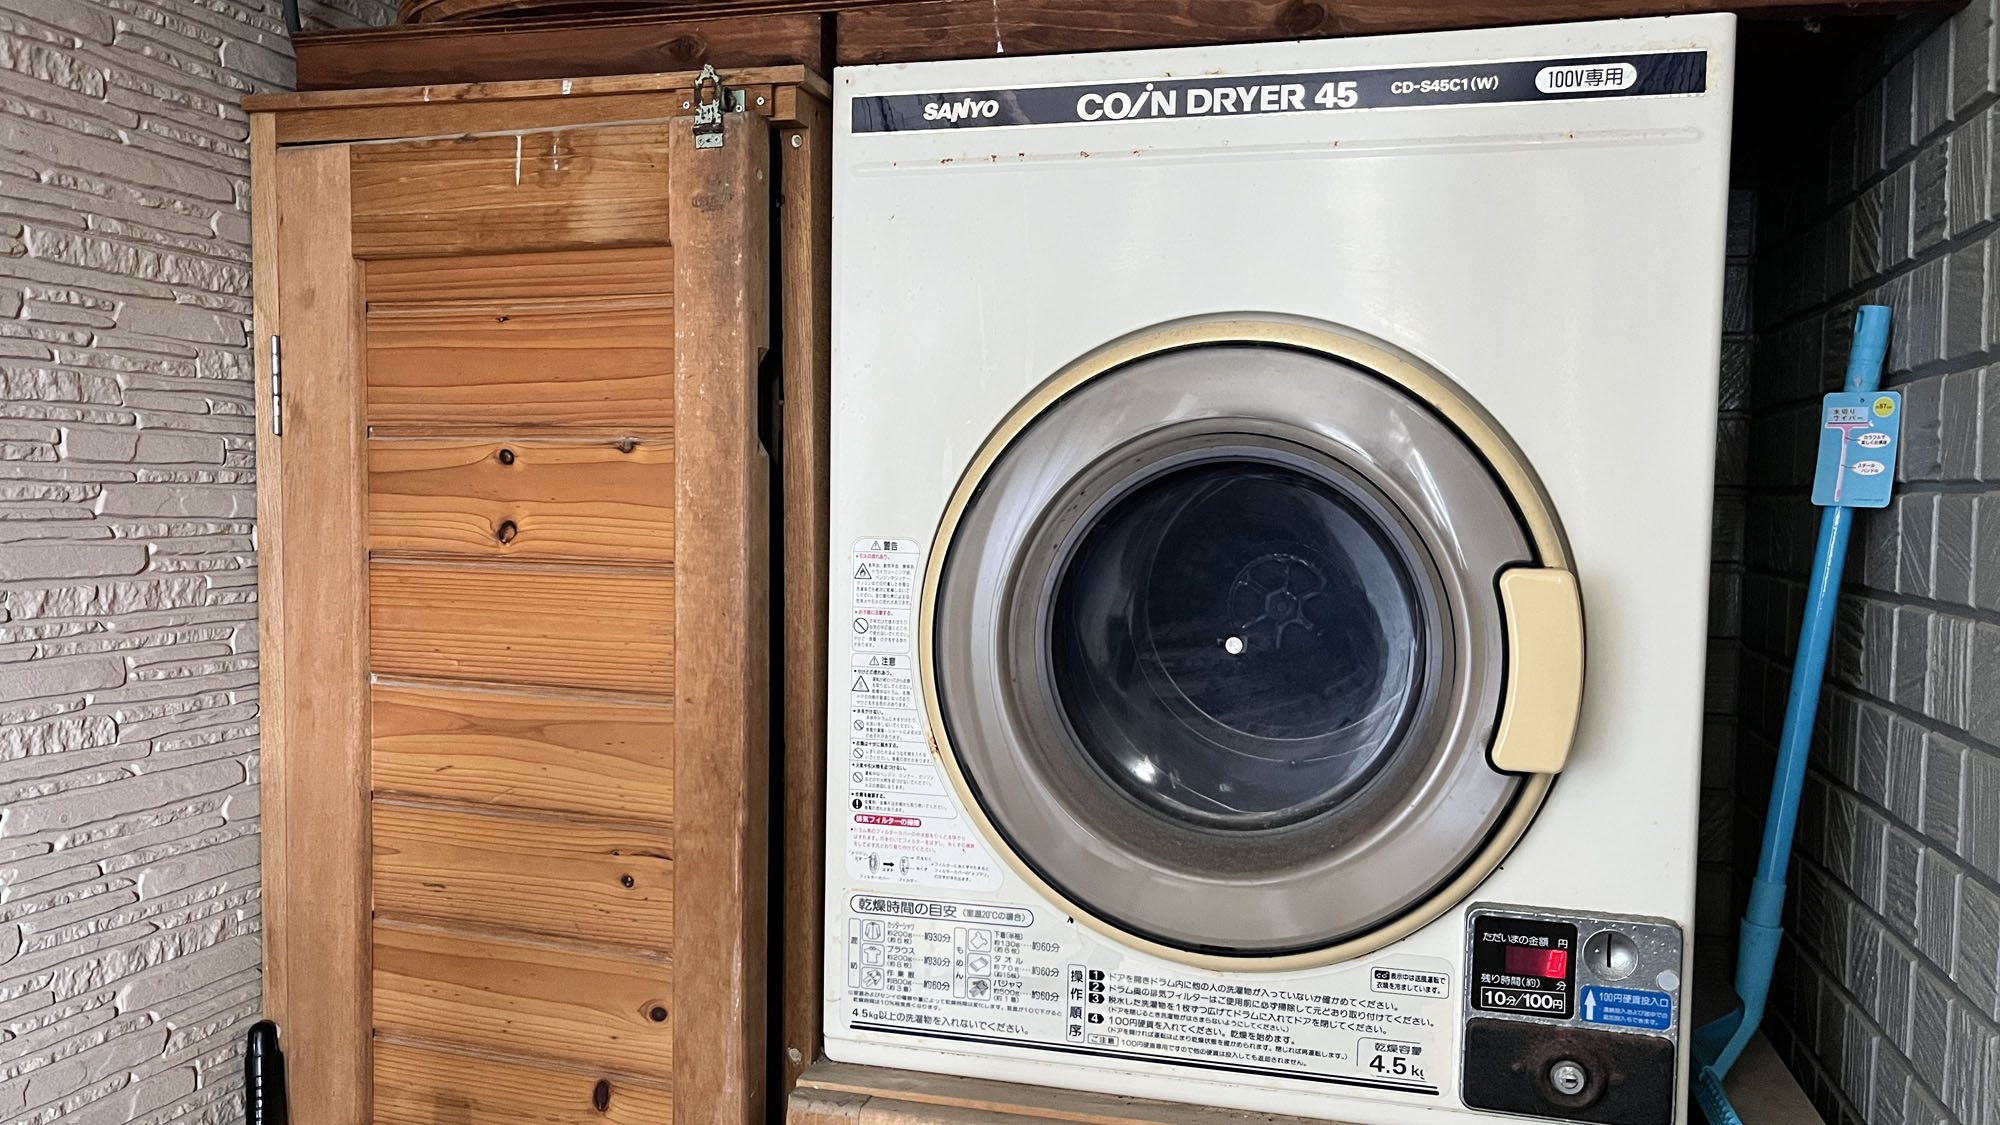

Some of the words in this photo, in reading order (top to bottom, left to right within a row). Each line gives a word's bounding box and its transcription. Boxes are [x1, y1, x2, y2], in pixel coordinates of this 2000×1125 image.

[1548, 67, 1624, 88] 100V専用
[1391, 76, 1499, 95] CD-S45C1(W)
[1186, 84, 1306, 114] DRYER
[1314, 81, 1358, 109] 45
[923, 98, 999, 123] SANYO
[883, 541, 898, 551] 警告
[881, 656, 896, 667] 注意
[858, 897, 957, 918] 乾燥時間の目安
[924, 932, 951, 943] 約30分
[1482, 932, 1549, 947] ただいまの金額
[1557, 938, 1569, 949] 円
[887, 945, 915, 955] ブラウス
[1032, 941, 1060, 953] 約60分
[924, 956, 951, 967] 約30分
[993, 955, 1023, 965] タオル
[1031, 966, 1060, 978] 約60分
[923, 980, 950, 991] 約60分
[993, 979, 1023, 989] パジャマ
[1092, 982, 1099, 992] 2
[1480, 973, 1541, 988] 残り時間(約)
[1555, 980, 1567, 991] 分
[1031, 990, 1060, 1002] 約60分
[1109, 972, 1399, 1012] ドアを開きドラム内に他の人の洗濯物が入っていないか確かめてください。
[1069, 970, 1083, 1037] 操作順序
[1092, 994, 1099, 1003] 3
[1485, 990, 1563, 1010] 10分/100円
[1599, 992, 1669, 1008] 100円硬貨投入口
[1091, 1014, 1099, 1023] 4
[1090, 1035, 1115, 1045] ご注意
[1374, 1042, 1422, 1056] 乾燥容量
[1369, 1054, 1407, 1075] 4.5
